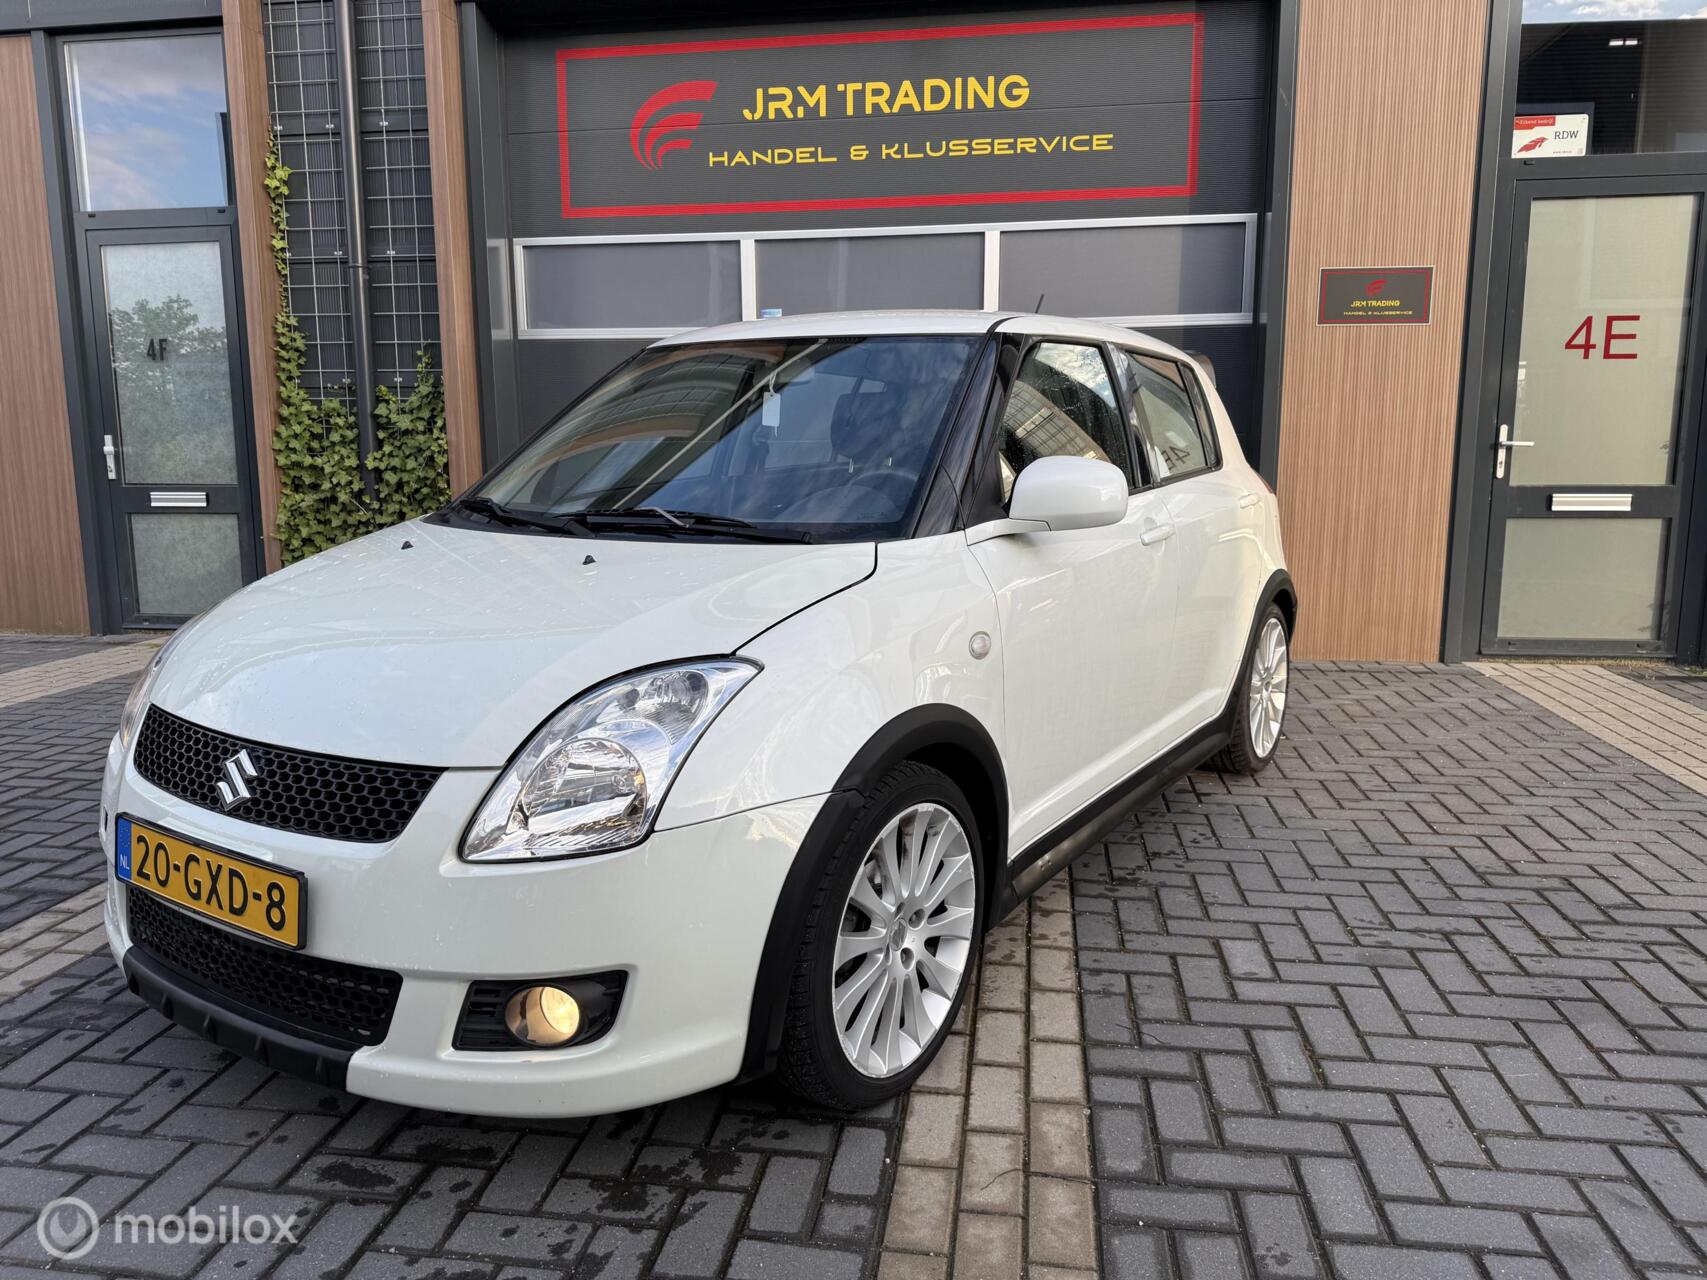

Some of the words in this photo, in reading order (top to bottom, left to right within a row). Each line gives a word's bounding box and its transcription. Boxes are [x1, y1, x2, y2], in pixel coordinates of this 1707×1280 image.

[742, 84, 827, 121] JRM
[836, 74, 1030, 116] TRADING
[708, 147, 837, 168] HANDEL
[849, 145, 869, 160] &
[881, 133, 1114, 160] KLUSSERVICE
[1554, 130, 1579, 140] RDW
[146, 338, 168, 361] 4F
[1564, 315, 1640, 360] 4E
[119, 853, 130, 870] NL
[136, 834, 286, 931] 20-GXD-8
